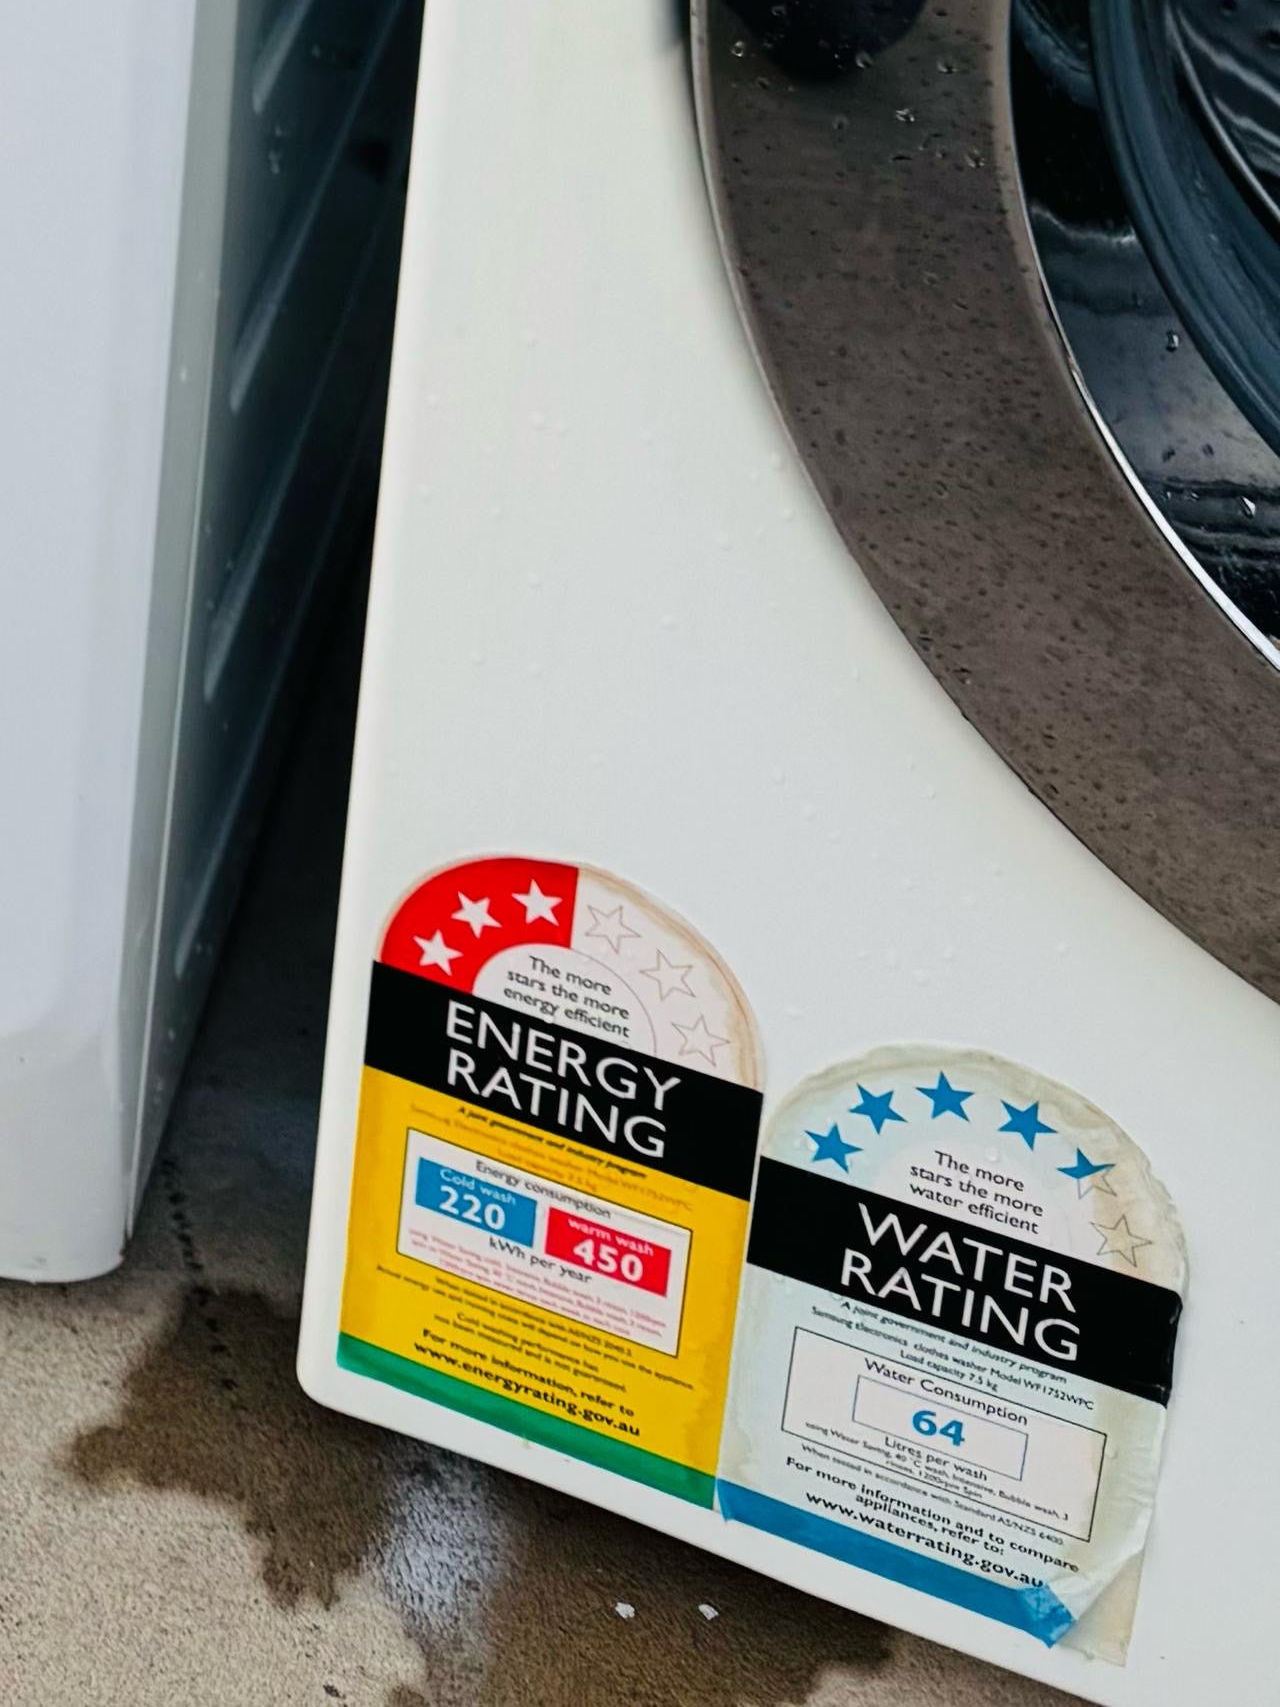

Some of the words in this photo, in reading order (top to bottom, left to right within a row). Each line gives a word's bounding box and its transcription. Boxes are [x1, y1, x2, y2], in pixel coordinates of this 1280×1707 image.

[507, 971, 546, 991] stars
[552, 985, 578, 1002] the
[584, 997, 629, 1019] more
[530, 955, 560, 978] The
[566, 972, 611, 995] more
[504, 988, 558, 1016] energy
[564, 1008, 630, 1037] efficient
[446, 1000, 681, 1111] ENERGY
[447, 1050, 665, 1158] RATING
[440, 1168, 475, 1190] Cold
[480, 1184, 516, 1205] wash
[476, 1160, 519, 1187] Energy
[525, 1180, 611, 1219] consumption
[910, 1165, 952, 1187] stars
[959, 1181, 987, 1198] the
[994, 1192, 1043, 1216] more
[935, 1150, 969, 1174] The
[976, 1167, 1024, 1192] more
[440, 1186, 505, 1231] 220
[910, 1184, 963, 1207] water
[968, 1203, 1039, 1234] efficient
[490, 1237, 525, 1259] kWh
[530, 1256, 556, 1270] per
[560, 1265, 592, 1283] year
[568, 1218, 612, 1241] warm
[616, 1234, 653, 1255] wash
[573, 1239, 643, 1282] 450
[858, 1203, 1076, 1313] WATER
[841, 1249, 1080, 1361] RATING
[841, 1302, 850, 1310] A
[949, 1338, 969, 1350] and
[971, 1343, 1017, 1367] industry
[1019, 1363, 1067, 1383] program
[900, 1350, 924, 1364] Load
[927, 1360, 965, 1379] capacity
[414, 1343, 640, 1436] www.energyrating.gov.au
[423, 1328, 445, 1345] For
[450, 1341, 487, 1360] more
[581, 1391, 614, 1409] refer
[620, 1405, 634, 1417] to
[865, 1357, 915, 1385] Water
[921, 1379, 1028, 1425] Consumption
[991, 1368, 1022, 1385] Model
[912, 1410, 966, 1446] 64
[885, 1437, 922, 1458] Litres
[926, 1454, 950, 1466] per
[954, 1463, 987, 1481] wash
[787, 1456, 812, 1472] For
[816, 1470, 856, 1490] more
[861, 1484, 951, 1525] information
[956, 1520, 983, 1537] and
[990, 1533, 1005, 1545] to
[1010, 1542, 1079, 1572] compare
[856, 1495, 937, 1532] appliances,
[942, 1527, 980, 1545] refer
[984, 1542, 1004, 1555] to:
[806, 1492, 1043, 1588] www.waterrating.gov.au
